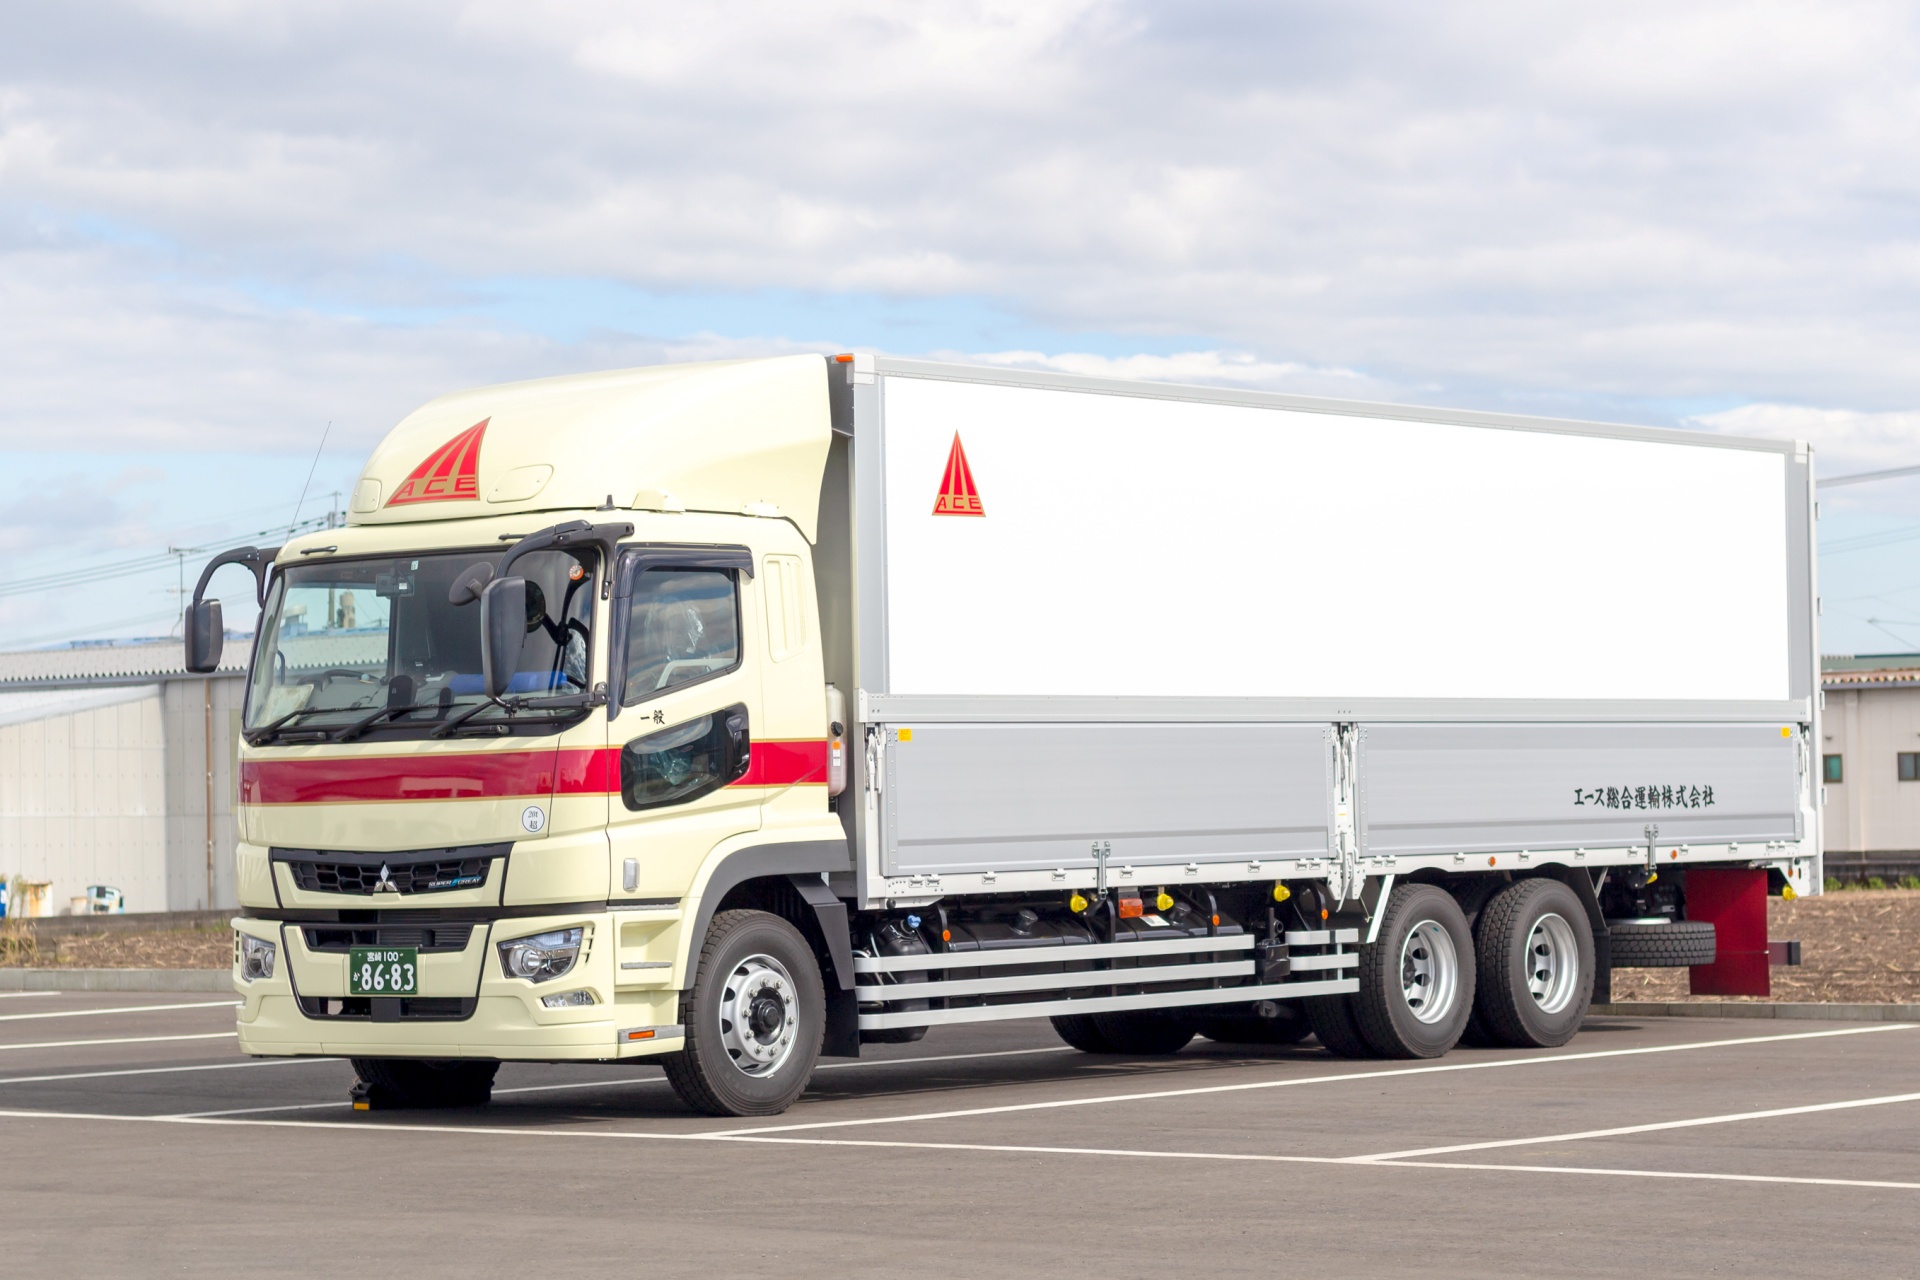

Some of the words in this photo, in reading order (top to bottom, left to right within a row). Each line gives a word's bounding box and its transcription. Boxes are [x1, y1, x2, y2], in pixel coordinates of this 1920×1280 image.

[391, 477, 476, 501] ACE
[935, 496, 982, 512] ACE
[640, 709, 665, 725] 一般
[1574, 784, 1715, 810] エース総合運輸株式会社
[428, 880, 452, 888] SUPER
[367, 951, 382, 962] 宮崎
[383, 951, 399, 962] 100
[361, 963, 414, 991] 86-83
